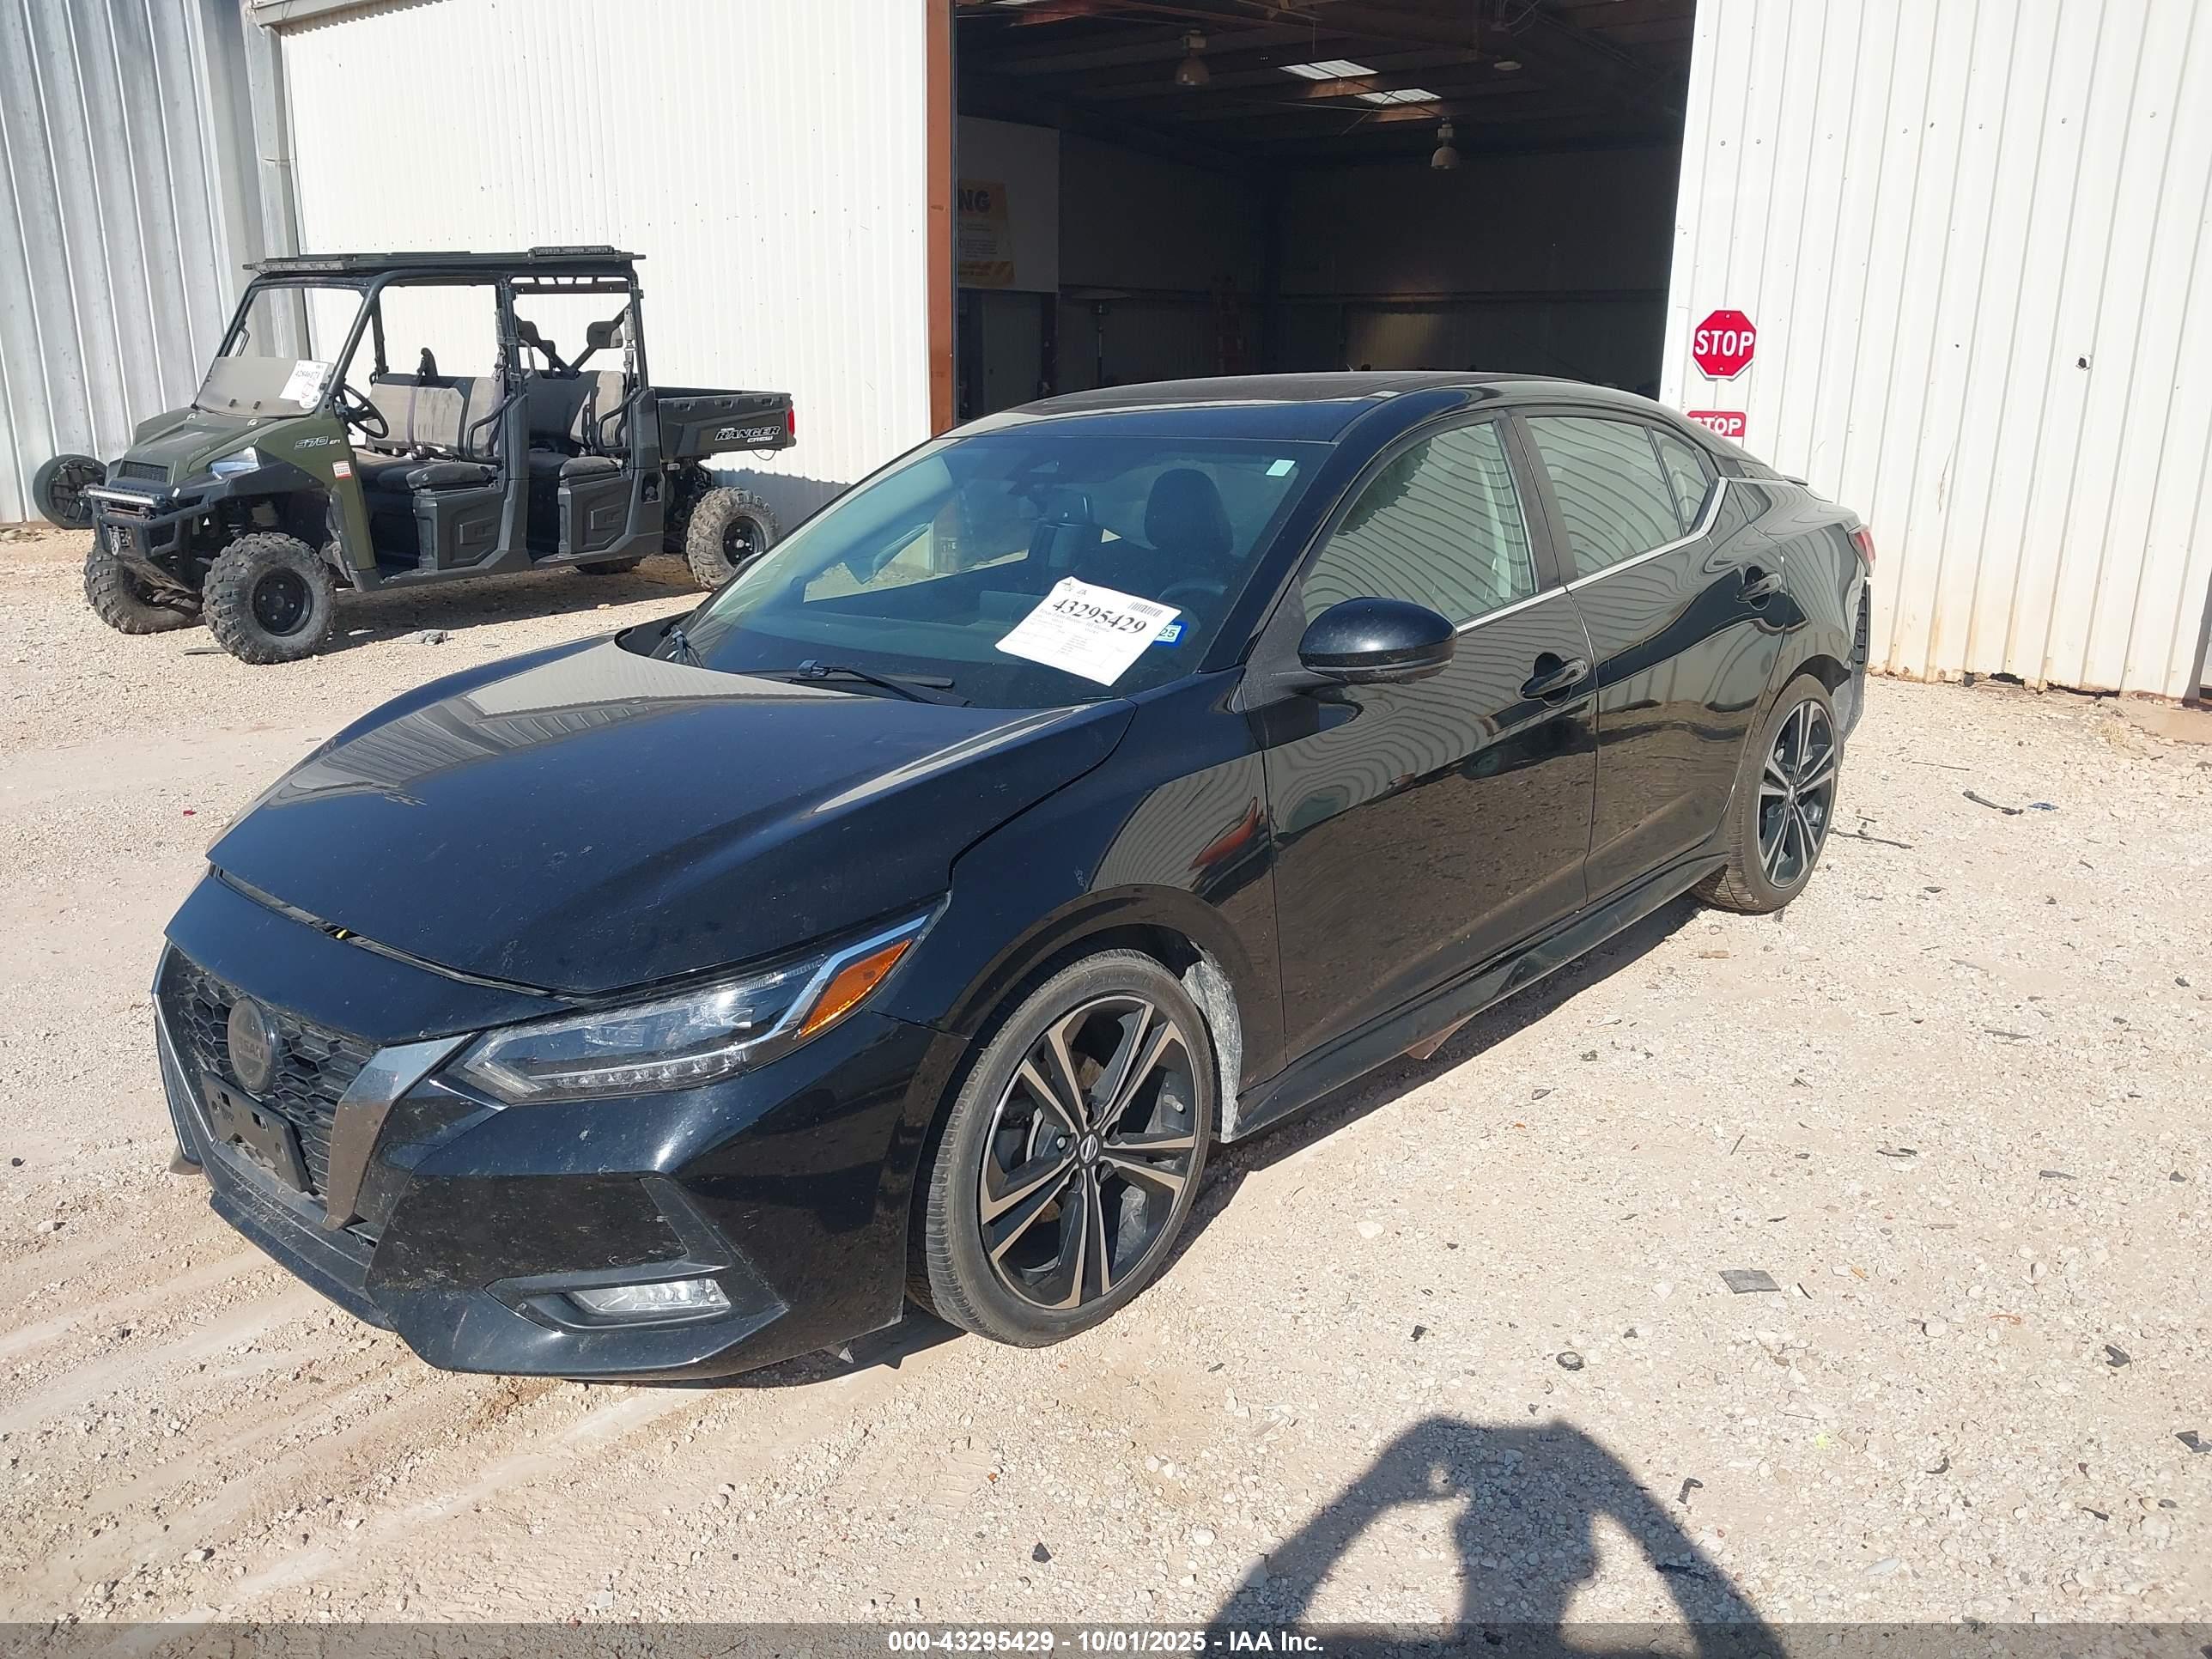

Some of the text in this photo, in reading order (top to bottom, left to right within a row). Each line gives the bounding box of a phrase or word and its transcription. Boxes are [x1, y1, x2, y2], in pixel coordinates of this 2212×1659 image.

[1695, 330, 1754, 356] STOP
[714, 426, 781, 441] RANGER
[1053, 599, 1146, 633] 43295429
[1159, 628, 1176, 638] 25
